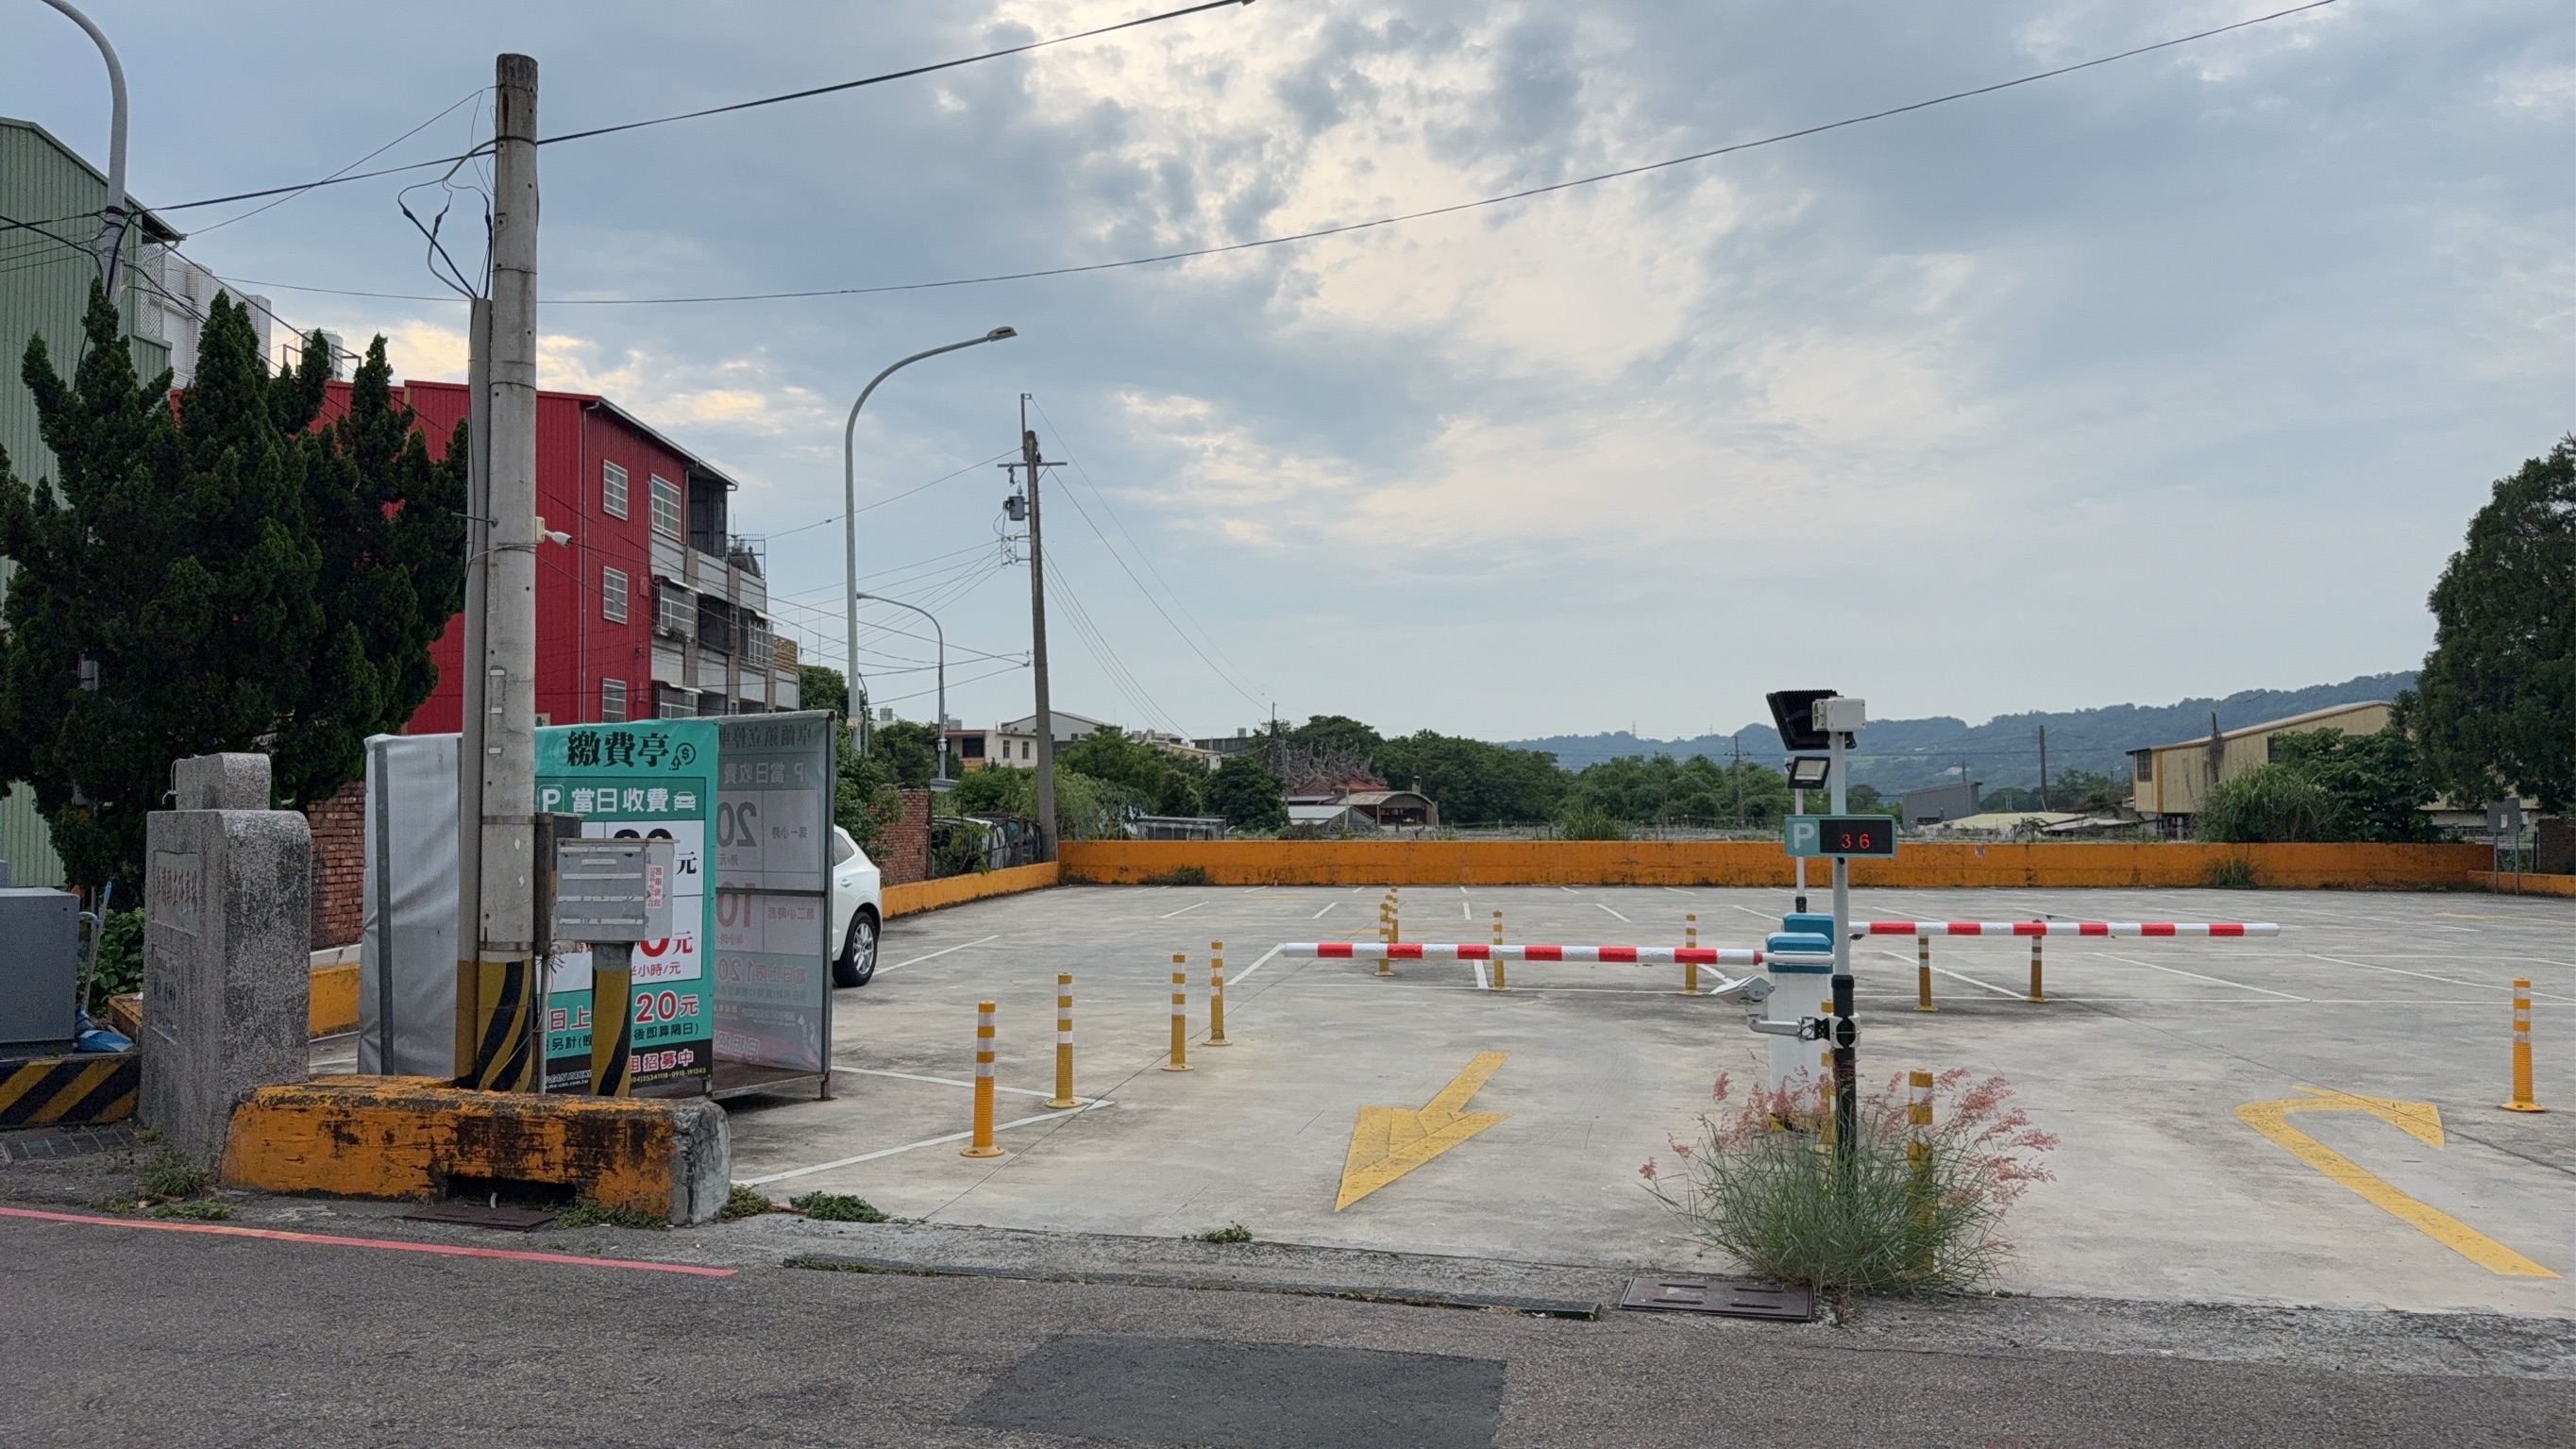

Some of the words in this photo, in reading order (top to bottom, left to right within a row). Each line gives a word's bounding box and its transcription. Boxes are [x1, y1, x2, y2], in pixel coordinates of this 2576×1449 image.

[567, 731, 669, 767] 繳費亭
[542, 788, 561, 812] P
[571, 787, 668, 813] 當日收費
[1793, 823, 1815, 849] P
